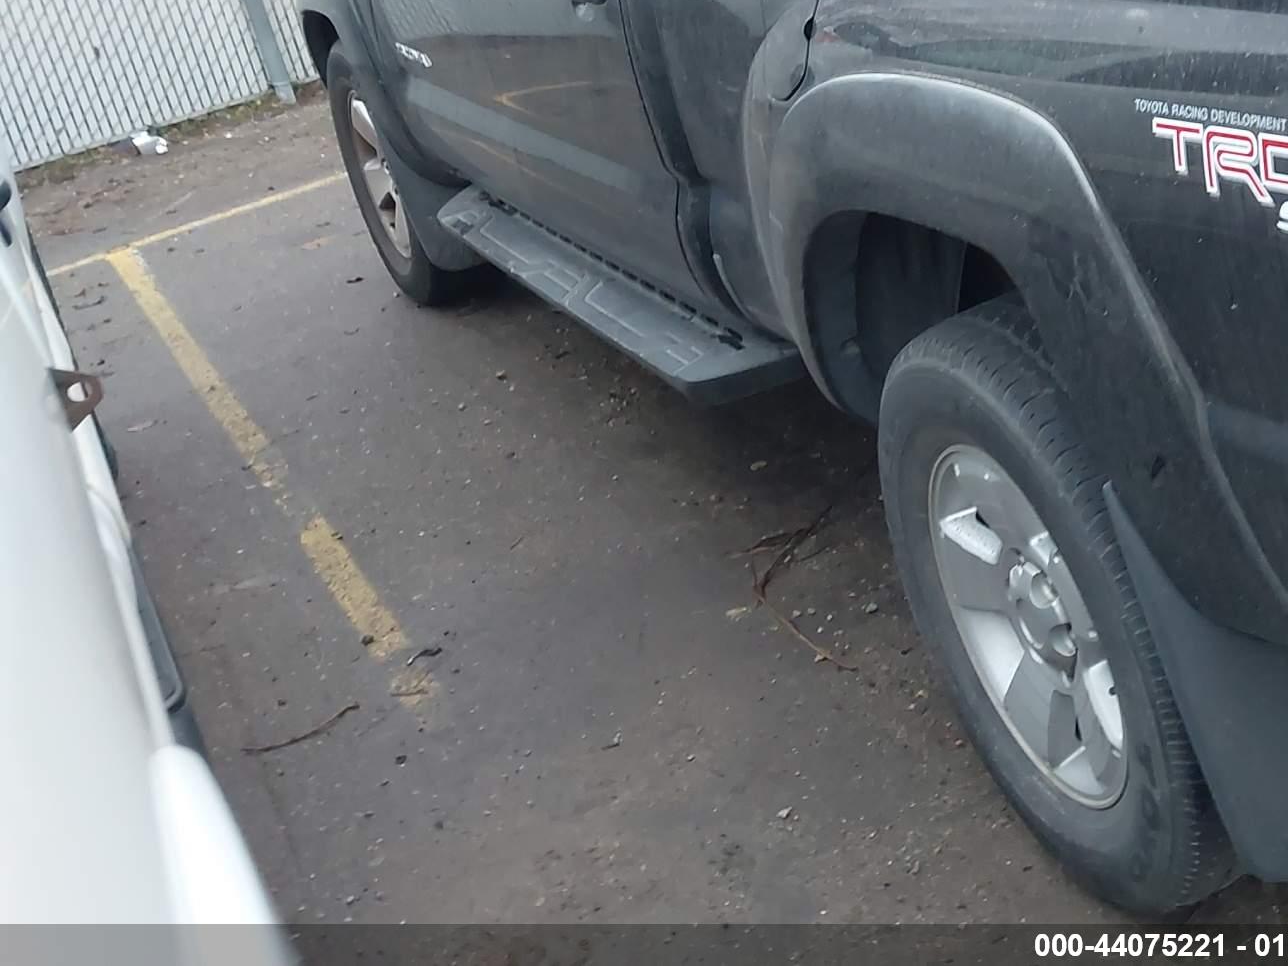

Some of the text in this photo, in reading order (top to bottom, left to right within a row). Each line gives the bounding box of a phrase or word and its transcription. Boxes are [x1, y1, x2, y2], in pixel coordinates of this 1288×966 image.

[1134, 98, 1288, 132] TOYOTA RACING DEVELOPMENT
